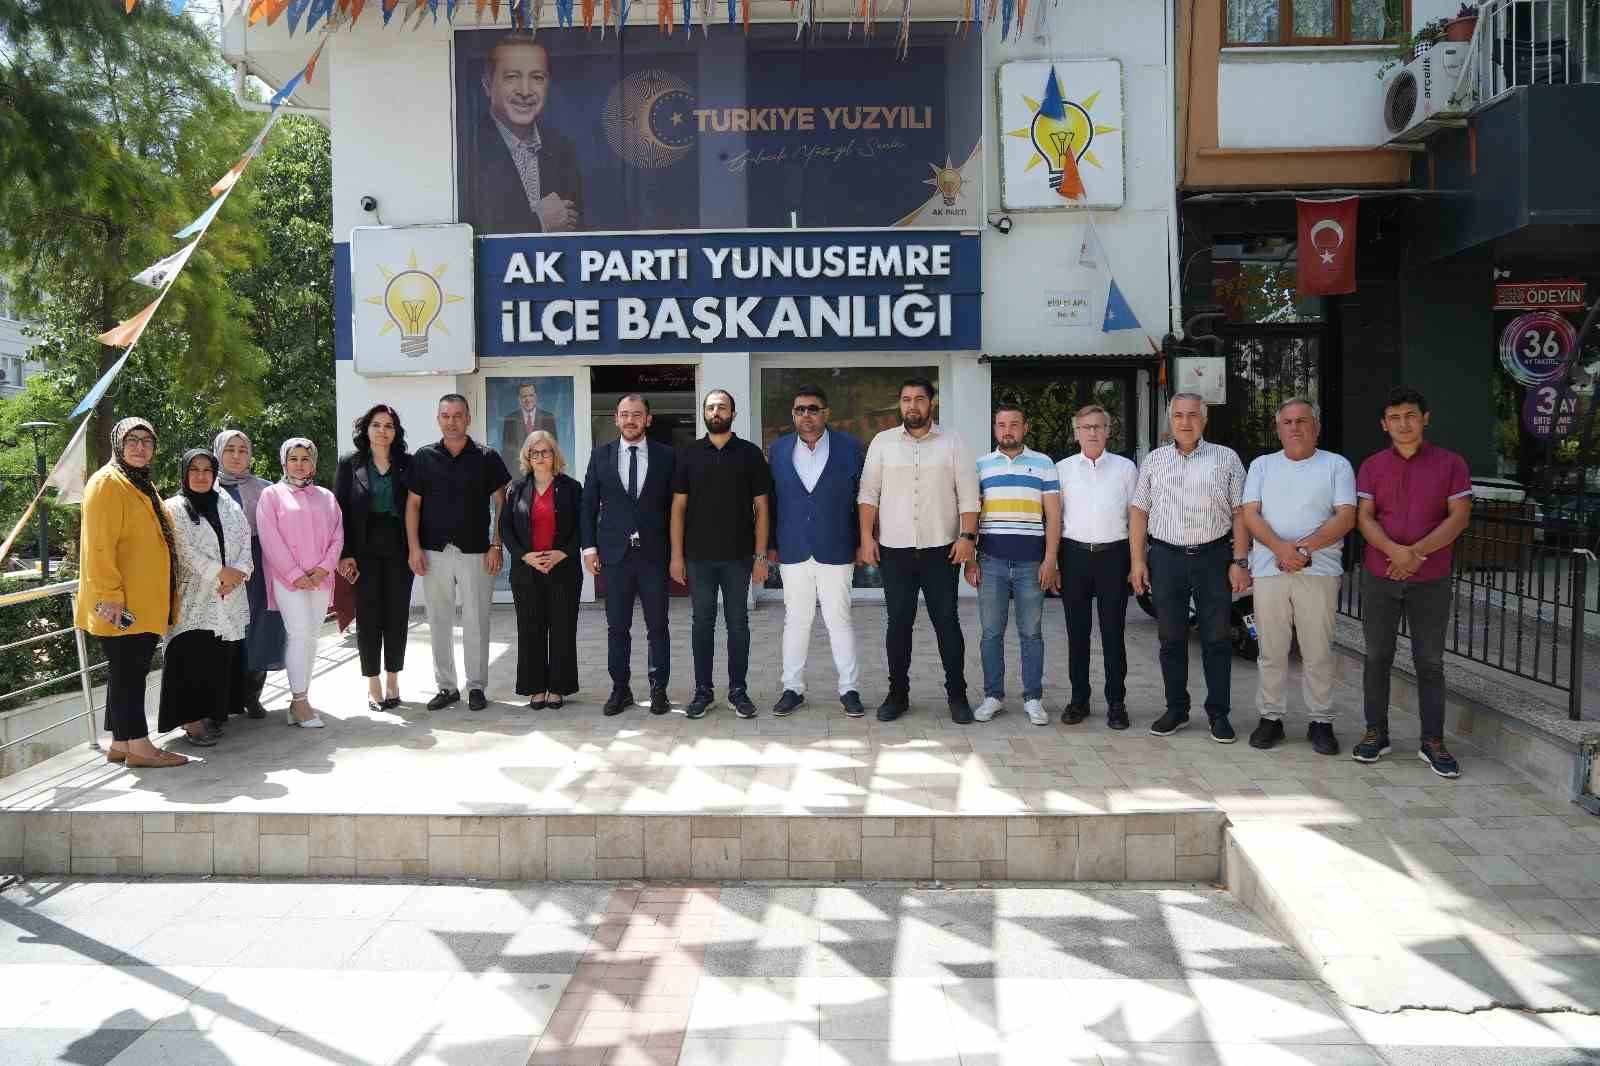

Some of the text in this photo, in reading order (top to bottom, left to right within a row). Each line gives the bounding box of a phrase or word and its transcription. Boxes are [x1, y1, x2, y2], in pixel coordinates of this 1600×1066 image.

[1423, 56, 1433, 99] arçelik
[693, 105, 932, 132] TÜRKİYE YÜZYILI
[503, 251, 565, 283] AK
[702, 245, 951, 279] YUNUSEMRE
[1527, 287, 1581, 304] ÖDEYİN
[617, 284, 952, 344] BAŞKANLIĞI
[1523, 329, 1560, 358] 36
[1536, 386, 1578, 415] 3 AY
